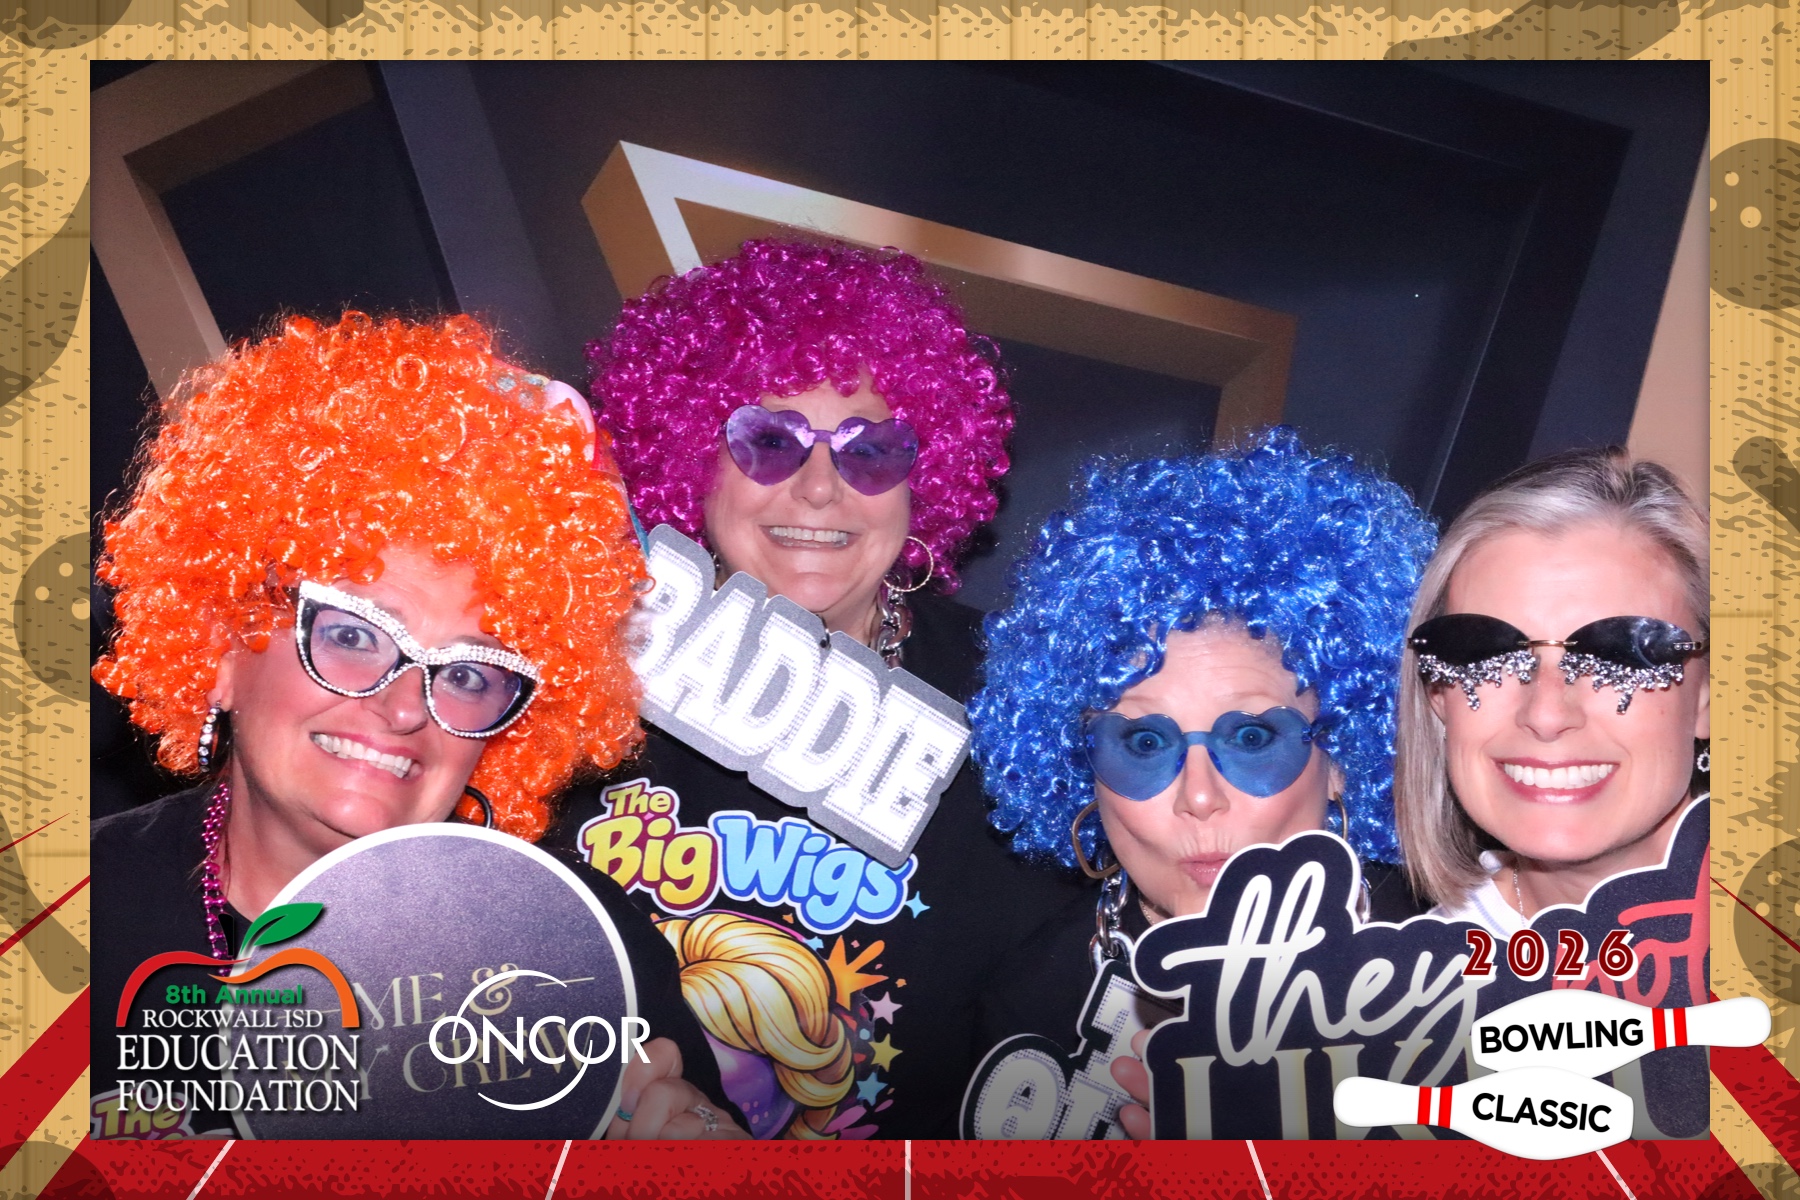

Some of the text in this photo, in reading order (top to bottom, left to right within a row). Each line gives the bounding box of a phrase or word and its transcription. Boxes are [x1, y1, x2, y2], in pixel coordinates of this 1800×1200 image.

[636, 541, 971, 853] BADDIE
[607, 783, 672, 815] The
[584, 814, 912, 928] Big Wigs
[352, 962, 519, 1031] ME &
[1160, 861, 1498, 1089] they
